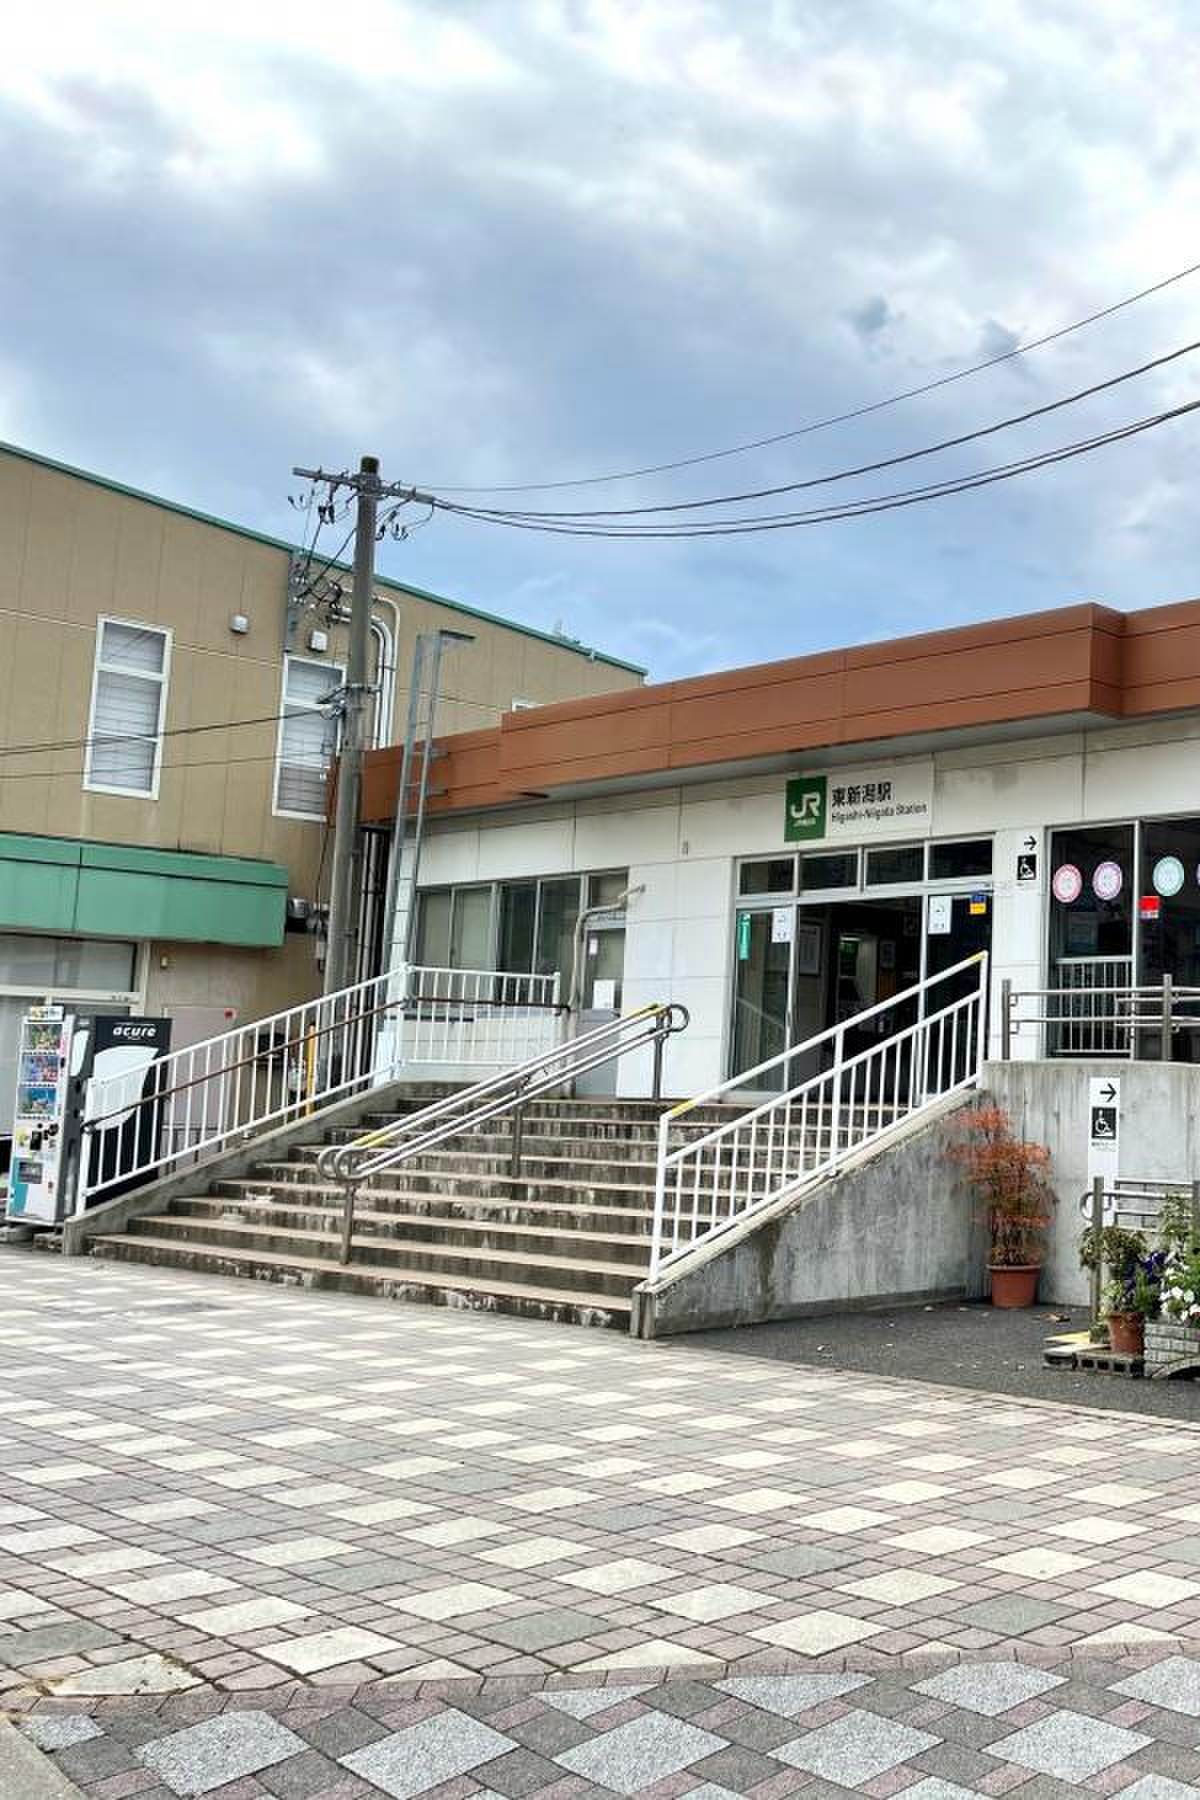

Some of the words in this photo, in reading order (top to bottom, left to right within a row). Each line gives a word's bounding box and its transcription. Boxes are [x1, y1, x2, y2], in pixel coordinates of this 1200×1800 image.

[790, 792, 821, 818] JR
[832, 781, 891, 807] 東新潟駅
[112, 1024, 157, 1037] acure
